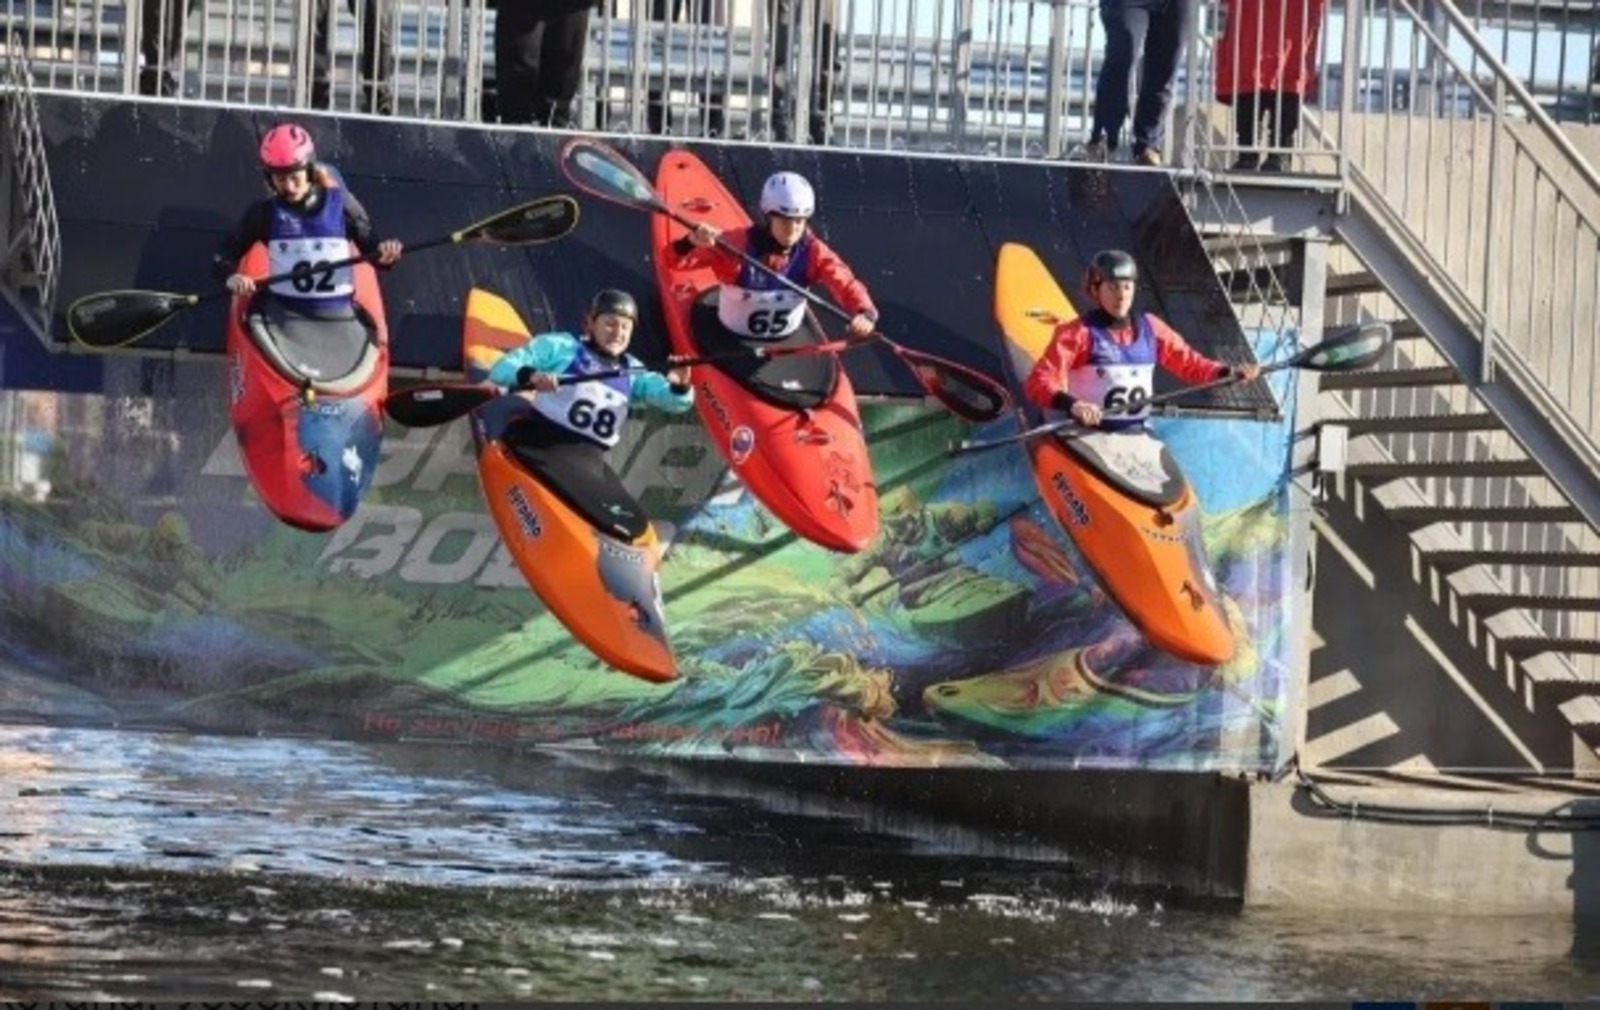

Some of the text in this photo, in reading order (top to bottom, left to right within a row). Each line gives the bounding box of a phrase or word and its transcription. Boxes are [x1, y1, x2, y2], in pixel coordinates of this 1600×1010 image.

[291, 260, 336, 293] 62
[747, 310, 790, 334] 65
[1104, 386, 1146, 416] 69
[568, 399, 617, 439] 68
